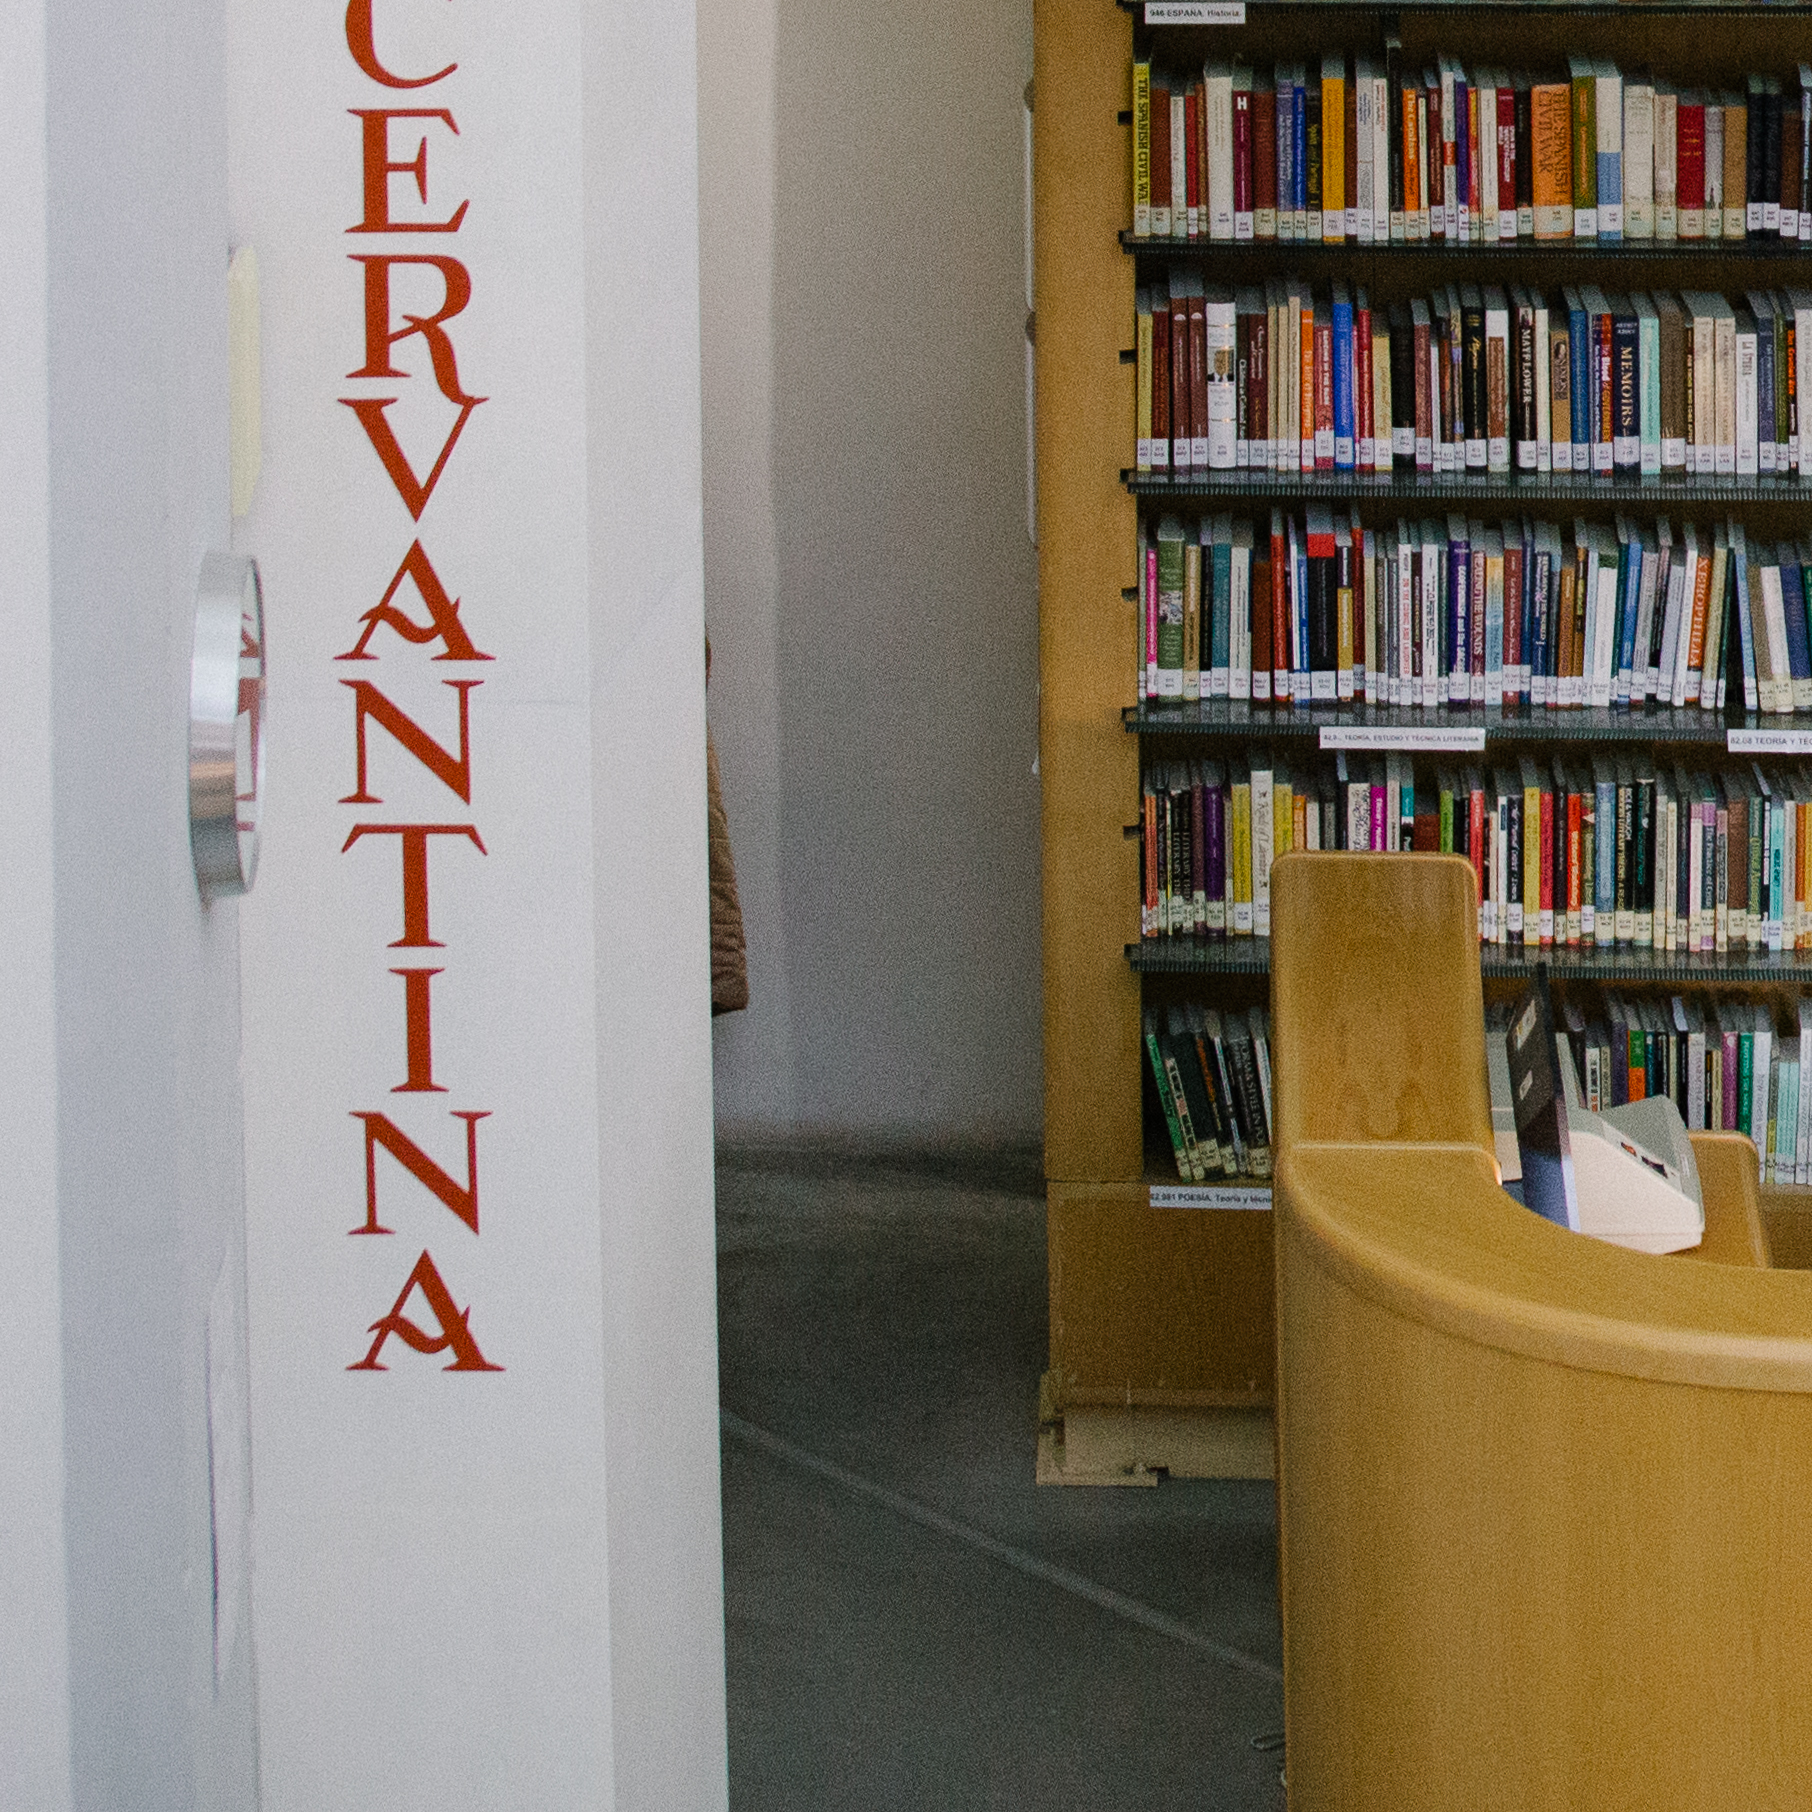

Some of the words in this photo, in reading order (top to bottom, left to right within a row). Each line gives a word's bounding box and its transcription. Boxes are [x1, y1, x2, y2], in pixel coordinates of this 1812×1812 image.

[1149, 9, 1165, 17] 946
[1138, 79, 1147, 97] THE
[1553, 92, 1565, 118] THE
[1137, 99, 1147, 149] SPANISH
[1538, 92, 1552, 135] CIVIL
[1137, 152, 1147, 177] CIVIL
[1538, 138, 1553, 173] WAR
[1554, 120, 1567, 190] SPANISH
[1520, 329, 1532, 404] MAYFLOWER
[1619, 346, 1634, 427] MEMOIRS
[1472, 553, 1483, 588] HEALING
[1472, 590, 1483, 608] THE
[1688, 558, 1709, 665] XEROPHILIA
[1472, 610, 1484, 655] WOUNDS
[1373, 735, 1404, 743] ESTUDIO
[1405, 735, 1410, 743] Y
[1443, 736, 1479, 744] LITERARIA
[1790, 737, 1795, 746] Y
[1242, 1197, 1248, 1206] y
